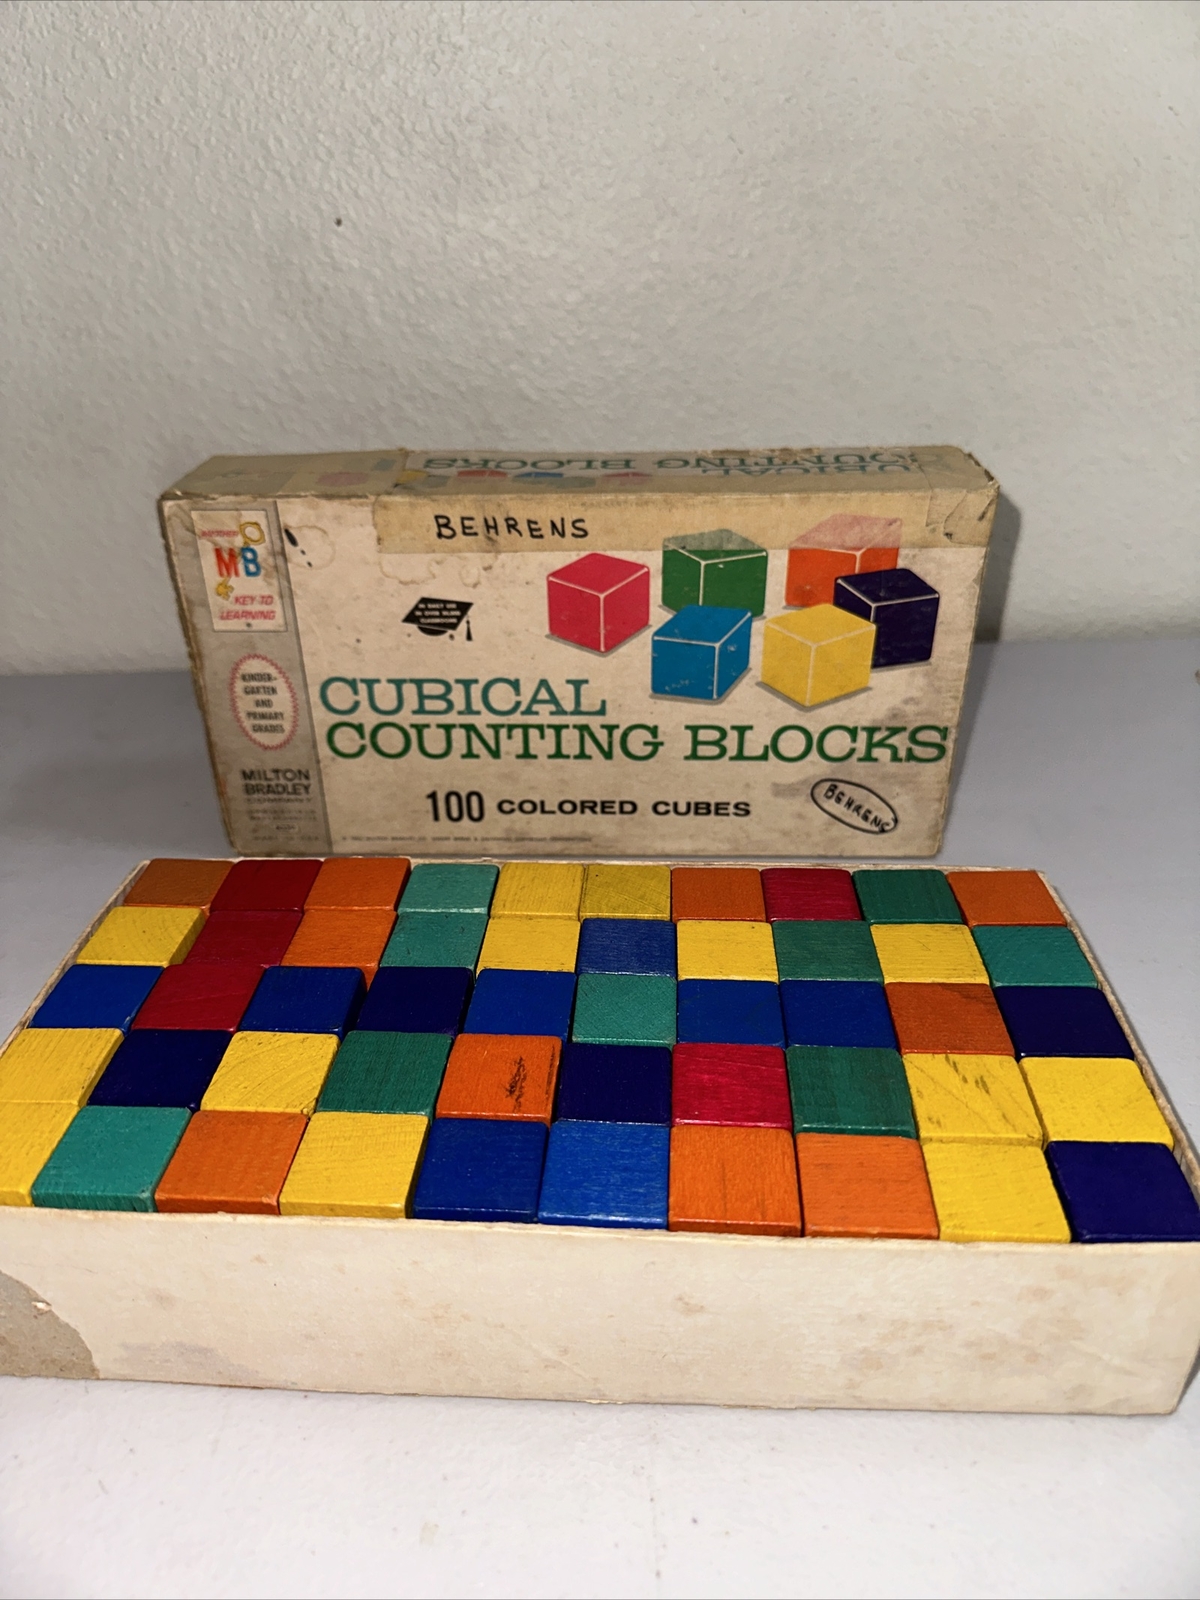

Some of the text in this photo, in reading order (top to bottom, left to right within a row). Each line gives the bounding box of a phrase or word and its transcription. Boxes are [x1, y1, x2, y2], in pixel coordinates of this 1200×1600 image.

[422, 457, 637, 470] BLOCKS
[434, 514, 589, 540] BEHRENS
[214, 546, 262, 578] MB
[234, 595, 274, 605] KEY TO
[220, 610, 276, 620] LEARNING
[244, 685, 278, 695] GARTEN
[319, 676, 607, 716] CUBICAL
[255, 699, 274, 708] AND
[246, 711, 284, 721] PRIMARY
[326, 721, 948, 763] COUNTING BLOCKS
[241, 769, 310, 781] MILTON
[244, 783, 311, 795] BRADLEY
[426, 790, 751, 822] 100 COLORED CUBES
[823, 783, 890, 833] BEHRENS
